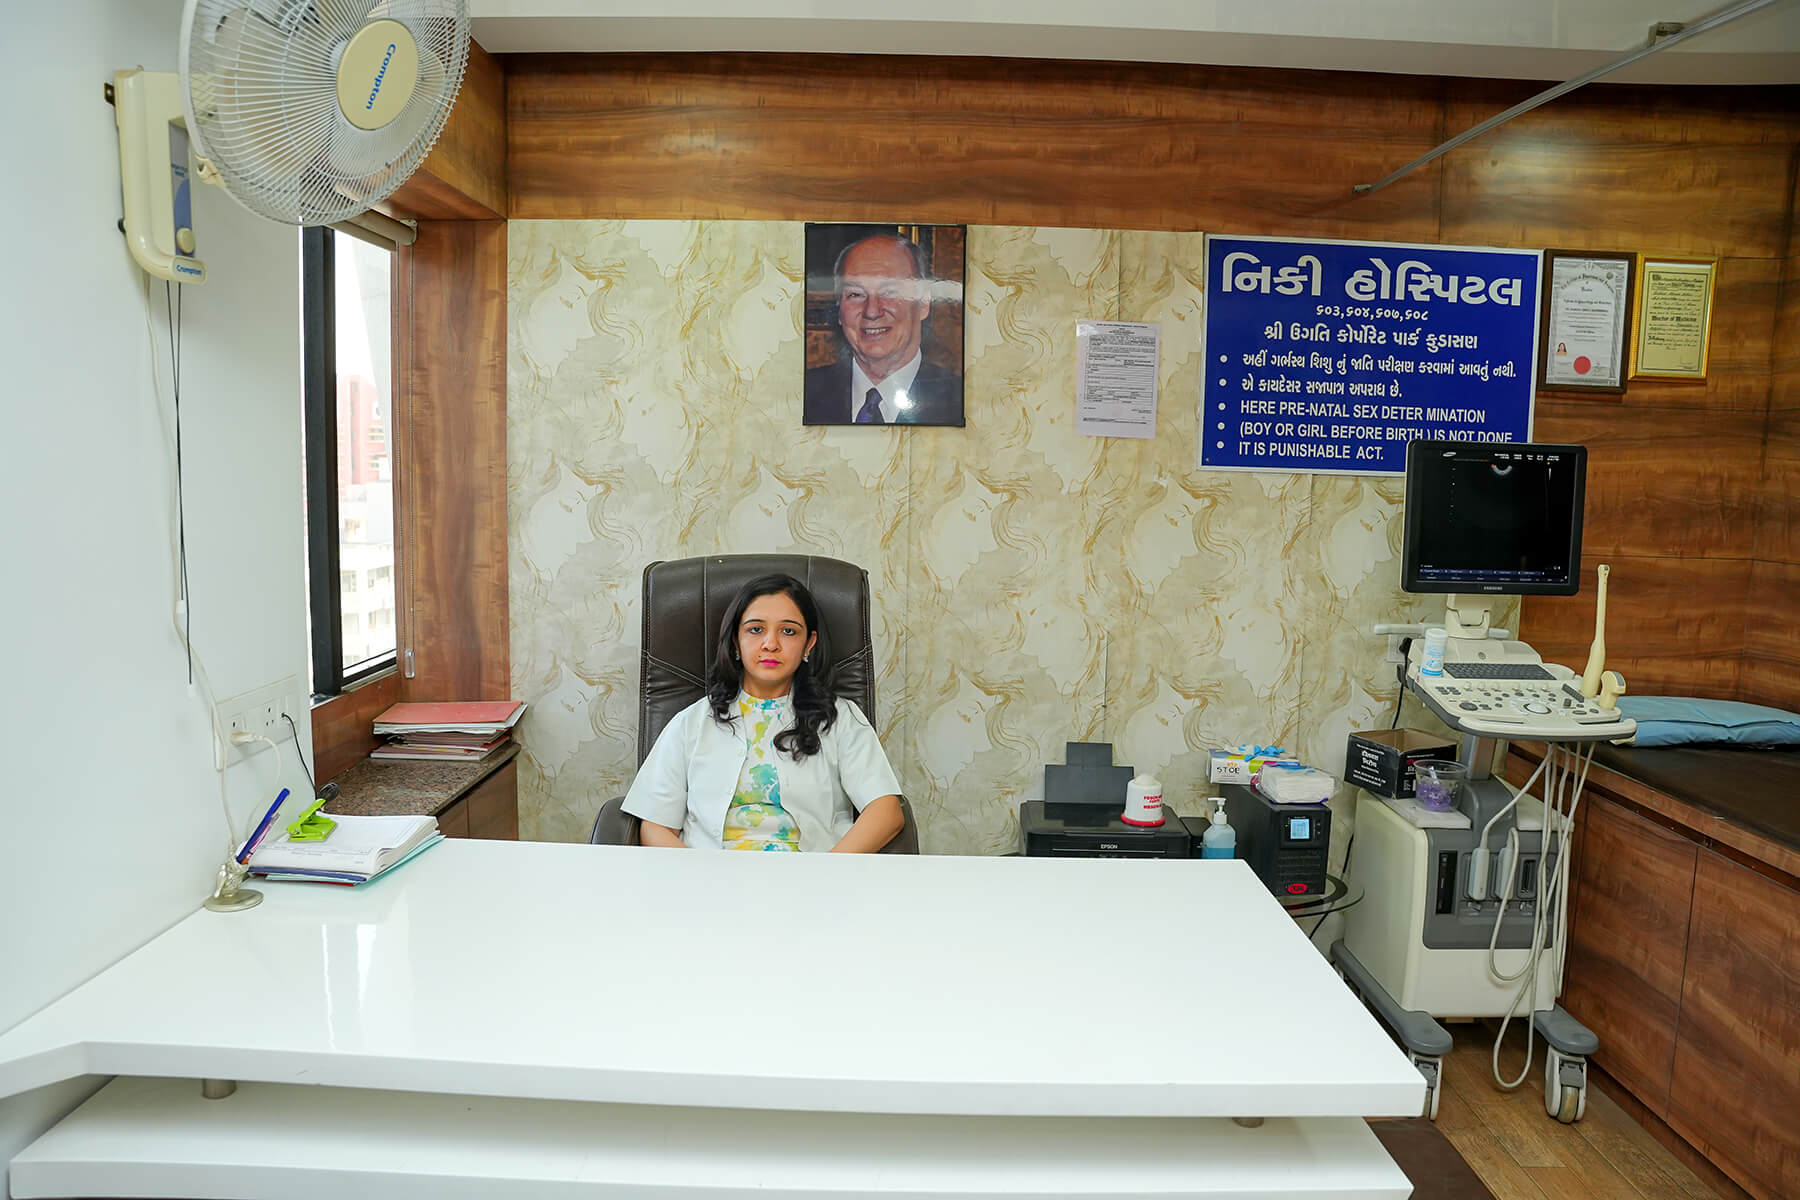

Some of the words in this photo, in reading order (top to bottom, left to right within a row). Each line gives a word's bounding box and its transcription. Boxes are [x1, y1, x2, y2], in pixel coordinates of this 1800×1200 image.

[365, 43, 396, 110] Crompton
[1222, 251, 1322, 297] નિકી
[1344, 257, 1522, 307] હોસ્પિટલ
[1263, 320, 1283, 340] શ્રી
[1290, 322, 1331, 342] ઉગતિ
[1392, 327, 1422, 346] પાર્ક
[1425, 333, 1478, 354] કુડાસણ
[1242, 348, 1268, 368] અહીં
[1270, 350, 1306, 368] ગર્ભસ્થ
[1309, 351, 1334, 375] શિશુ
[1336, 353, 1347, 376] નું
[1350, 353, 1374, 372] જાતિ
[1377, 354, 1415, 375] પરીક્ષણ
[1417, 358, 1455, 375] કરવામાં
[1458, 359, 1490, 382] આવતું
[1492, 360, 1517, 378] નથી.
[1241, 372, 1254, 392] એ
[1258, 373, 1302, 393] કાયદેસર
[1305, 380, 1345, 395] સજાપાત્ર
[1348, 382, 1386, 397] અપરાધ
[1389, 378, 1403, 398] છે.
[1240, 399, 1276, 415] HERE
[1279, 401, 1350, 418] PRE-NATAL
[1352, 404, 1379, 419] SEX
[1381, 405, 1423, 421] DETER
[1426, 407, 1486, 424] MINATION
[1239, 421, 1273, 439] (BOY
[1274, 422, 1294, 437] OR
[1297, 423, 1328, 438] GIRL
[1330, 424, 1383, 441] BEFORE
[1385, 427, 1423, 441] BIRTH
[1434, 429, 1446, 441] IS
[1449, 430, 1475, 442] NOT
[1478, 431, 1513, 443] DONE
[1238, 441, 1252, 456] IT
[1253, 441, 1266, 456] IS
[1269, 442, 1351, 459] PUNISHABLE
[1355, 445, 1384, 460] ACT.
